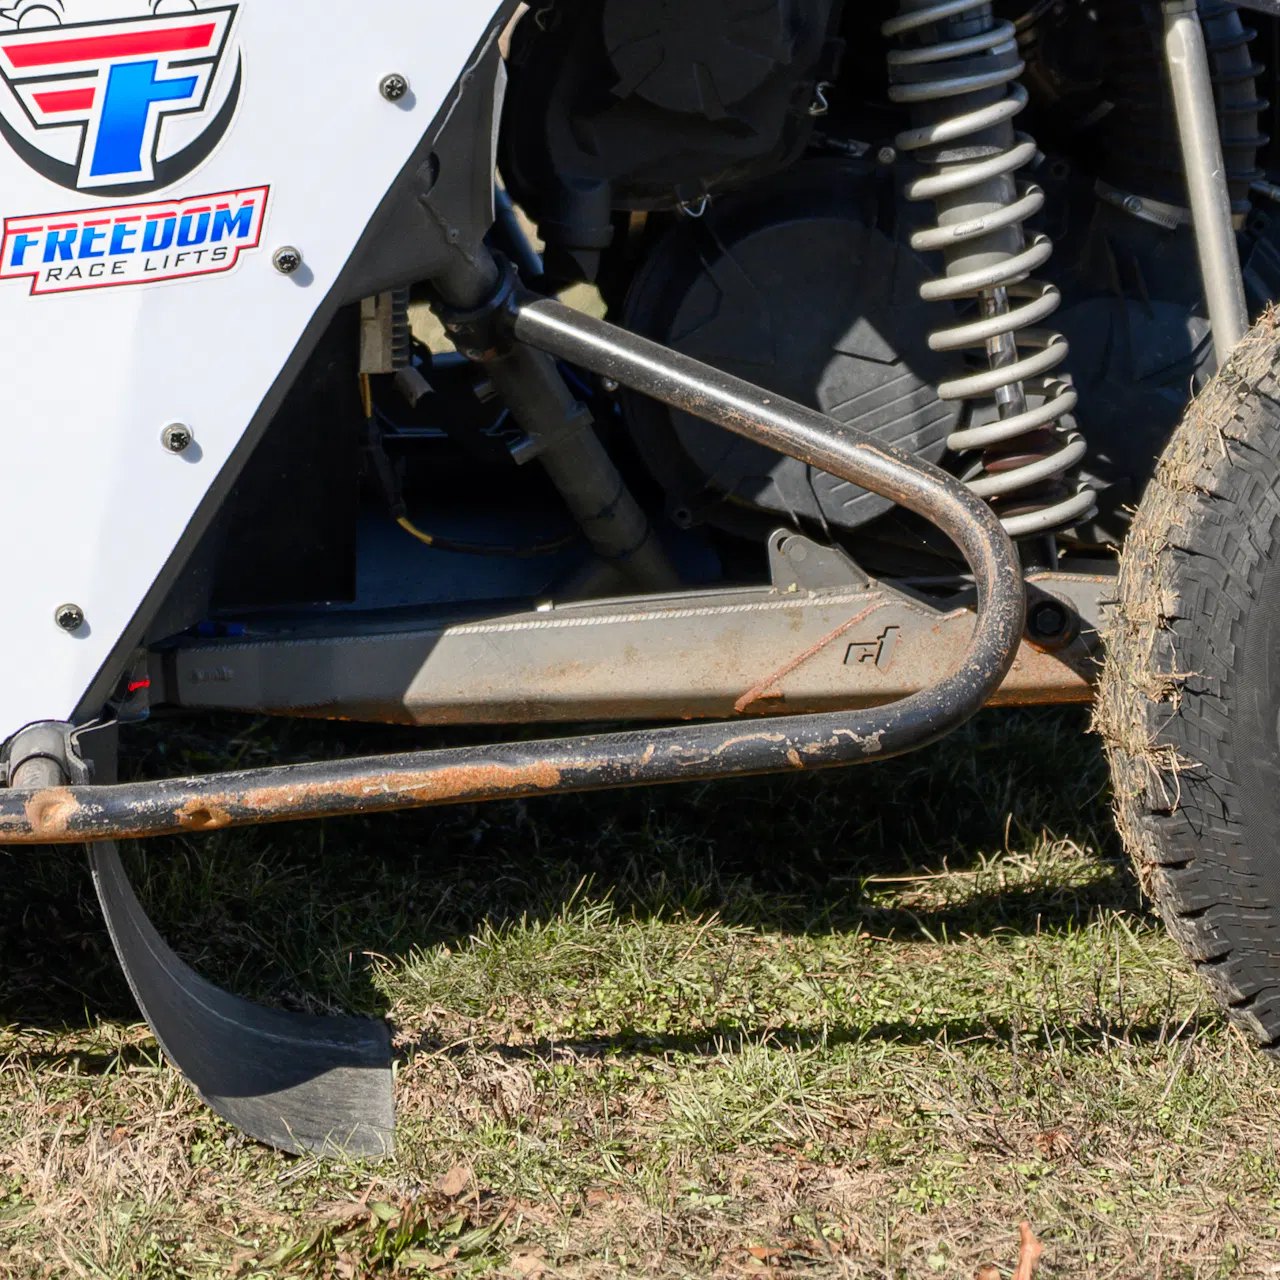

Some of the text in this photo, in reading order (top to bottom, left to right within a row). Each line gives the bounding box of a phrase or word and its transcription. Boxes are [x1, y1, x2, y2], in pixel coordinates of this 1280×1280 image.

[6, 199, 256, 268] FREEDOM
[45, 246, 228, 283] RACE LIFTS
